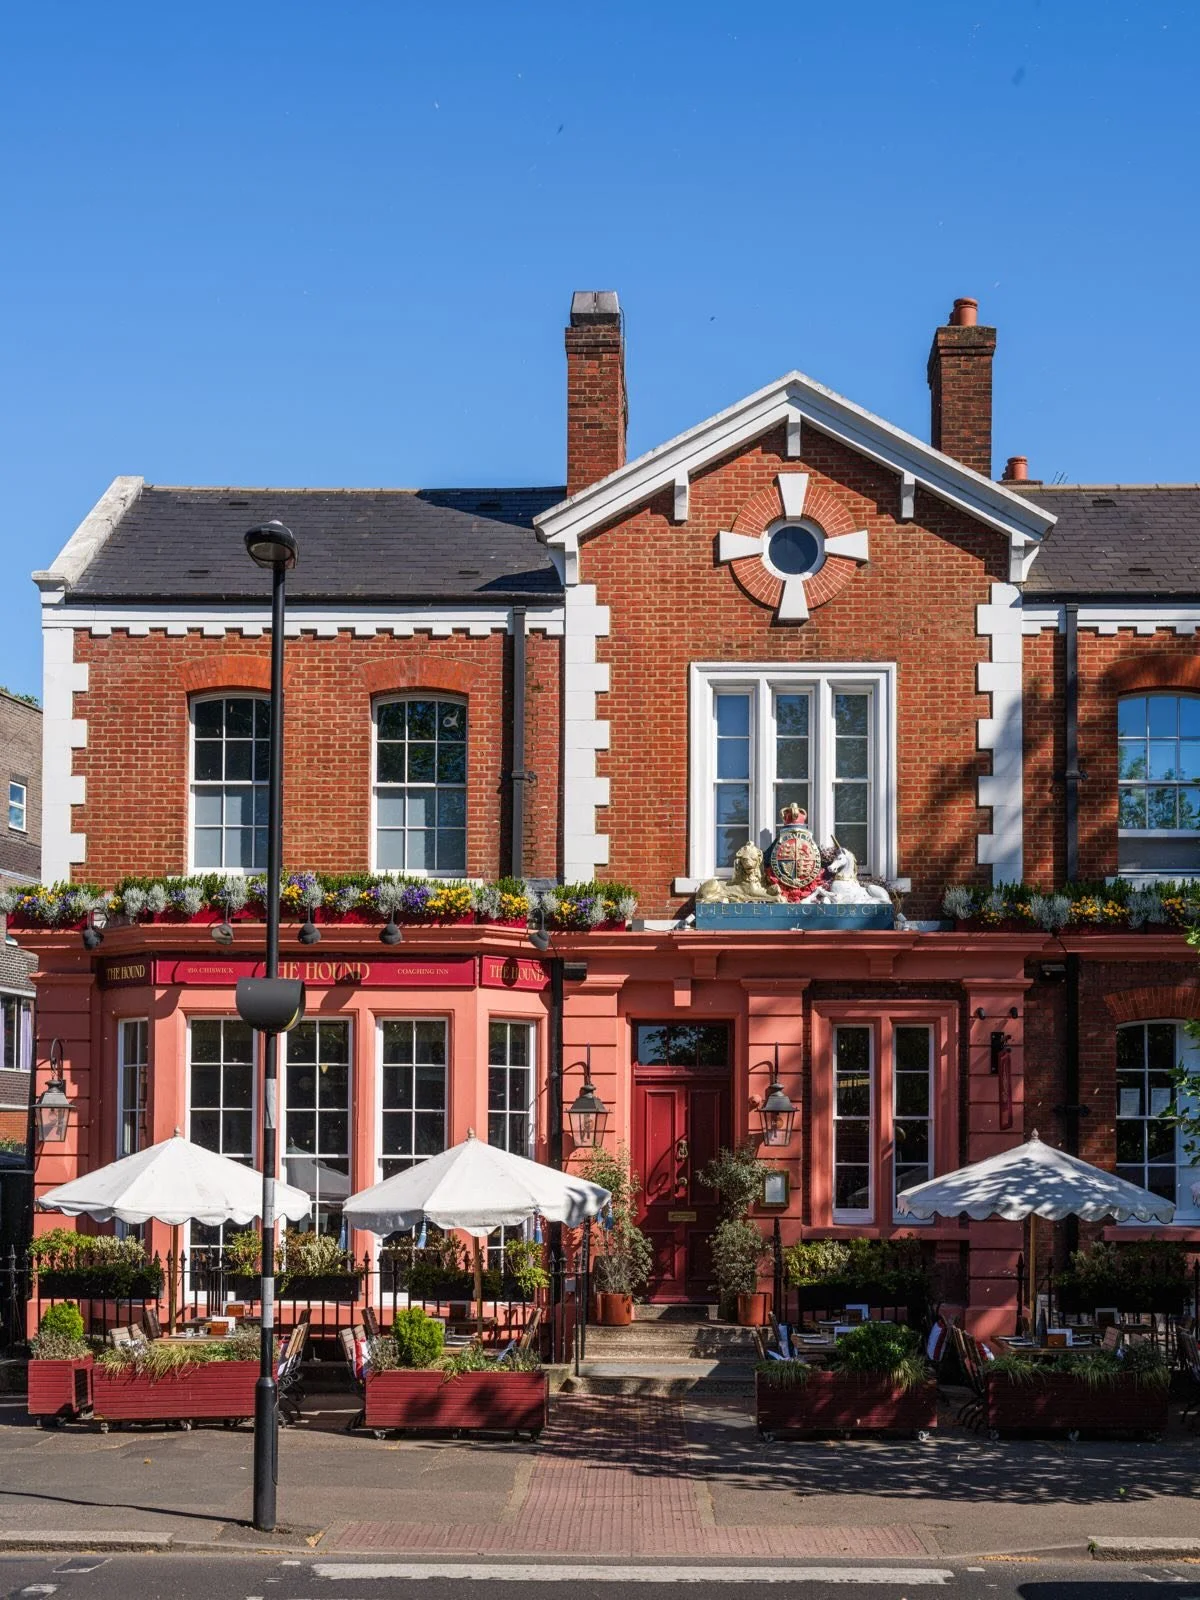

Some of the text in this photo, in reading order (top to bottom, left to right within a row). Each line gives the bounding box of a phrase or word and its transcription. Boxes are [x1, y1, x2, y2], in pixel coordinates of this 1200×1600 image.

[700, 903, 890, 916] DIEU ET MON DROIT
[107, 965, 145, 980] THE HOUND
[262, 962, 370, 980] HE HOUND
[490, 964, 544, 982] THE HOUND
